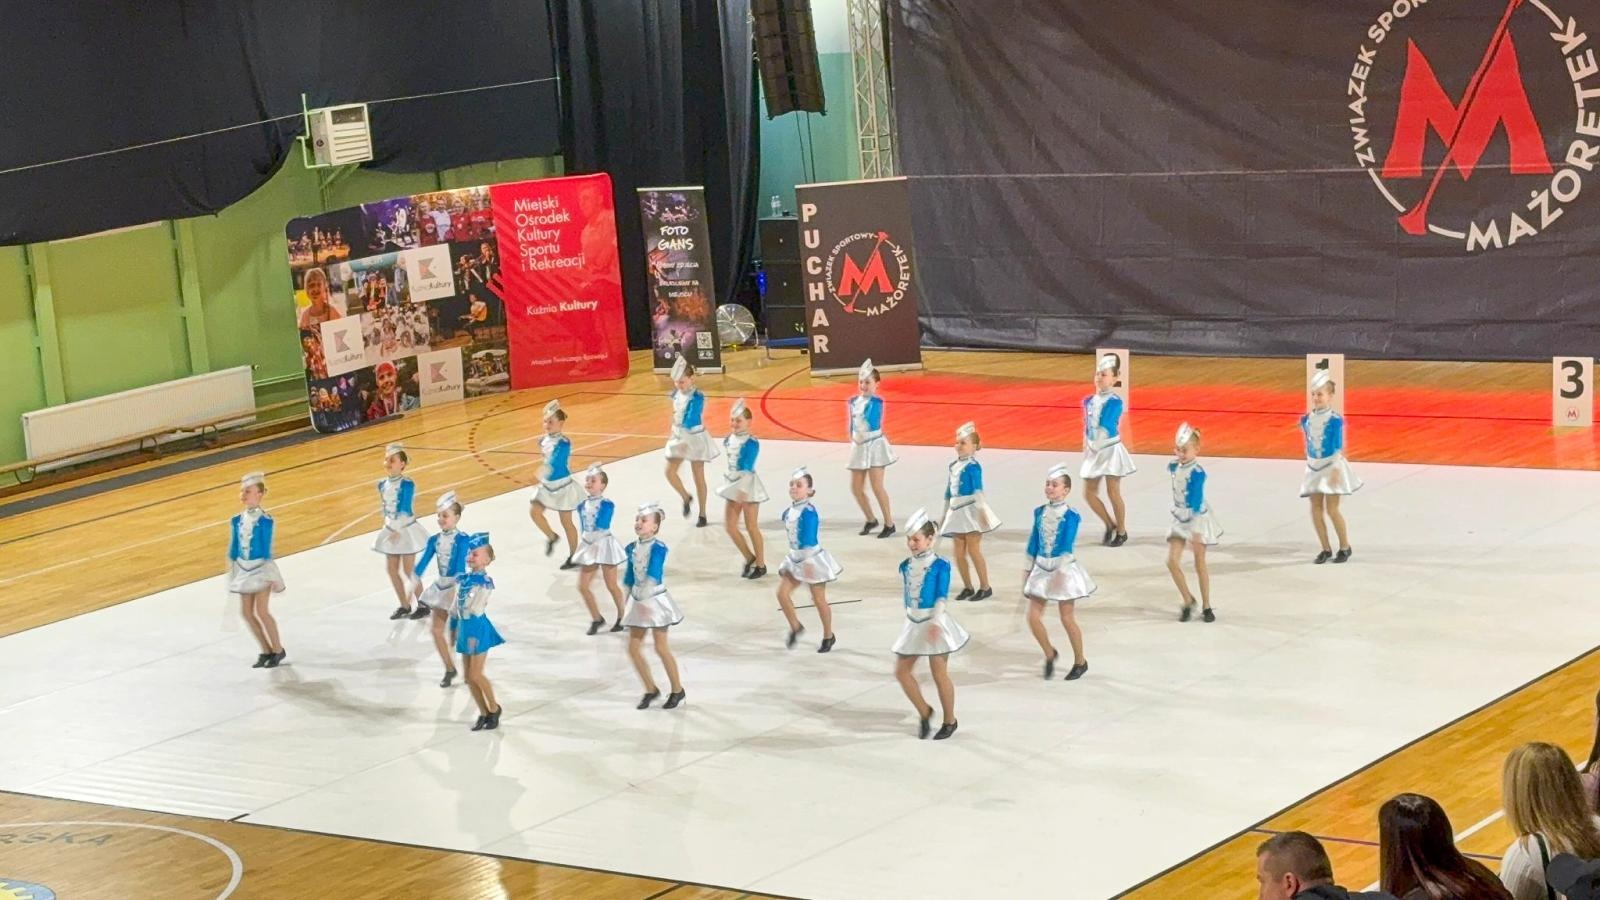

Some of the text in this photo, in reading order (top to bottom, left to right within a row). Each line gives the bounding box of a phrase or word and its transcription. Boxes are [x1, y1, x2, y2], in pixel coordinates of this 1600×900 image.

[514, 194, 559, 213] Miejski
[515, 208, 570, 228] Ośrodek
[517, 226, 560, 242] Kultury
[660, 225, 689, 235] FOTO
[520, 243, 560, 257] Sportu
[657, 238, 694, 250] GANS
[832, 232, 875, 254] SPORTOWY
[521, 253, 586, 272] i Rekreacji
[802, 203, 830, 354] PUCHAR
[866, 245, 911, 317] MAŻORETEK
[560, 299, 598, 311] Kultury
[1560, 360, 1585, 400] 3
